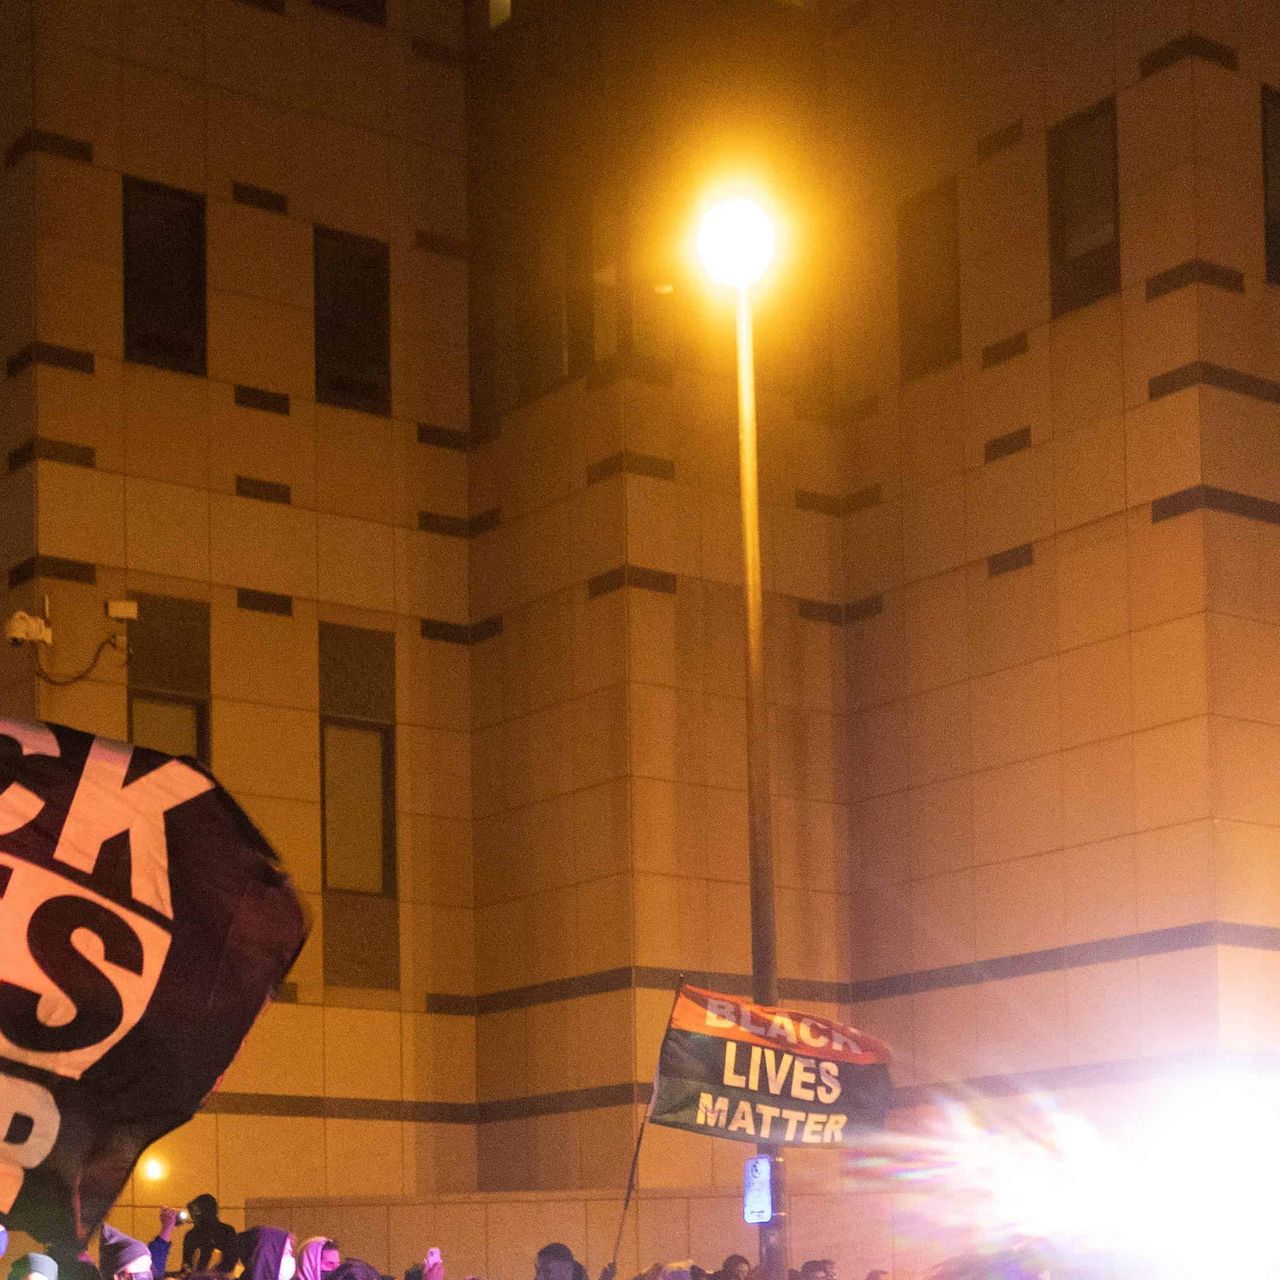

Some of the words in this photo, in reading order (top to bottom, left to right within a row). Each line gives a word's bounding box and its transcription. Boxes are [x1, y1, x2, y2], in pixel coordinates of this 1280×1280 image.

[705, 998, 862, 1055] BLACK
[723, 1041, 842, 1104] LIVES
[696, 1092, 848, 1144] MATTER
